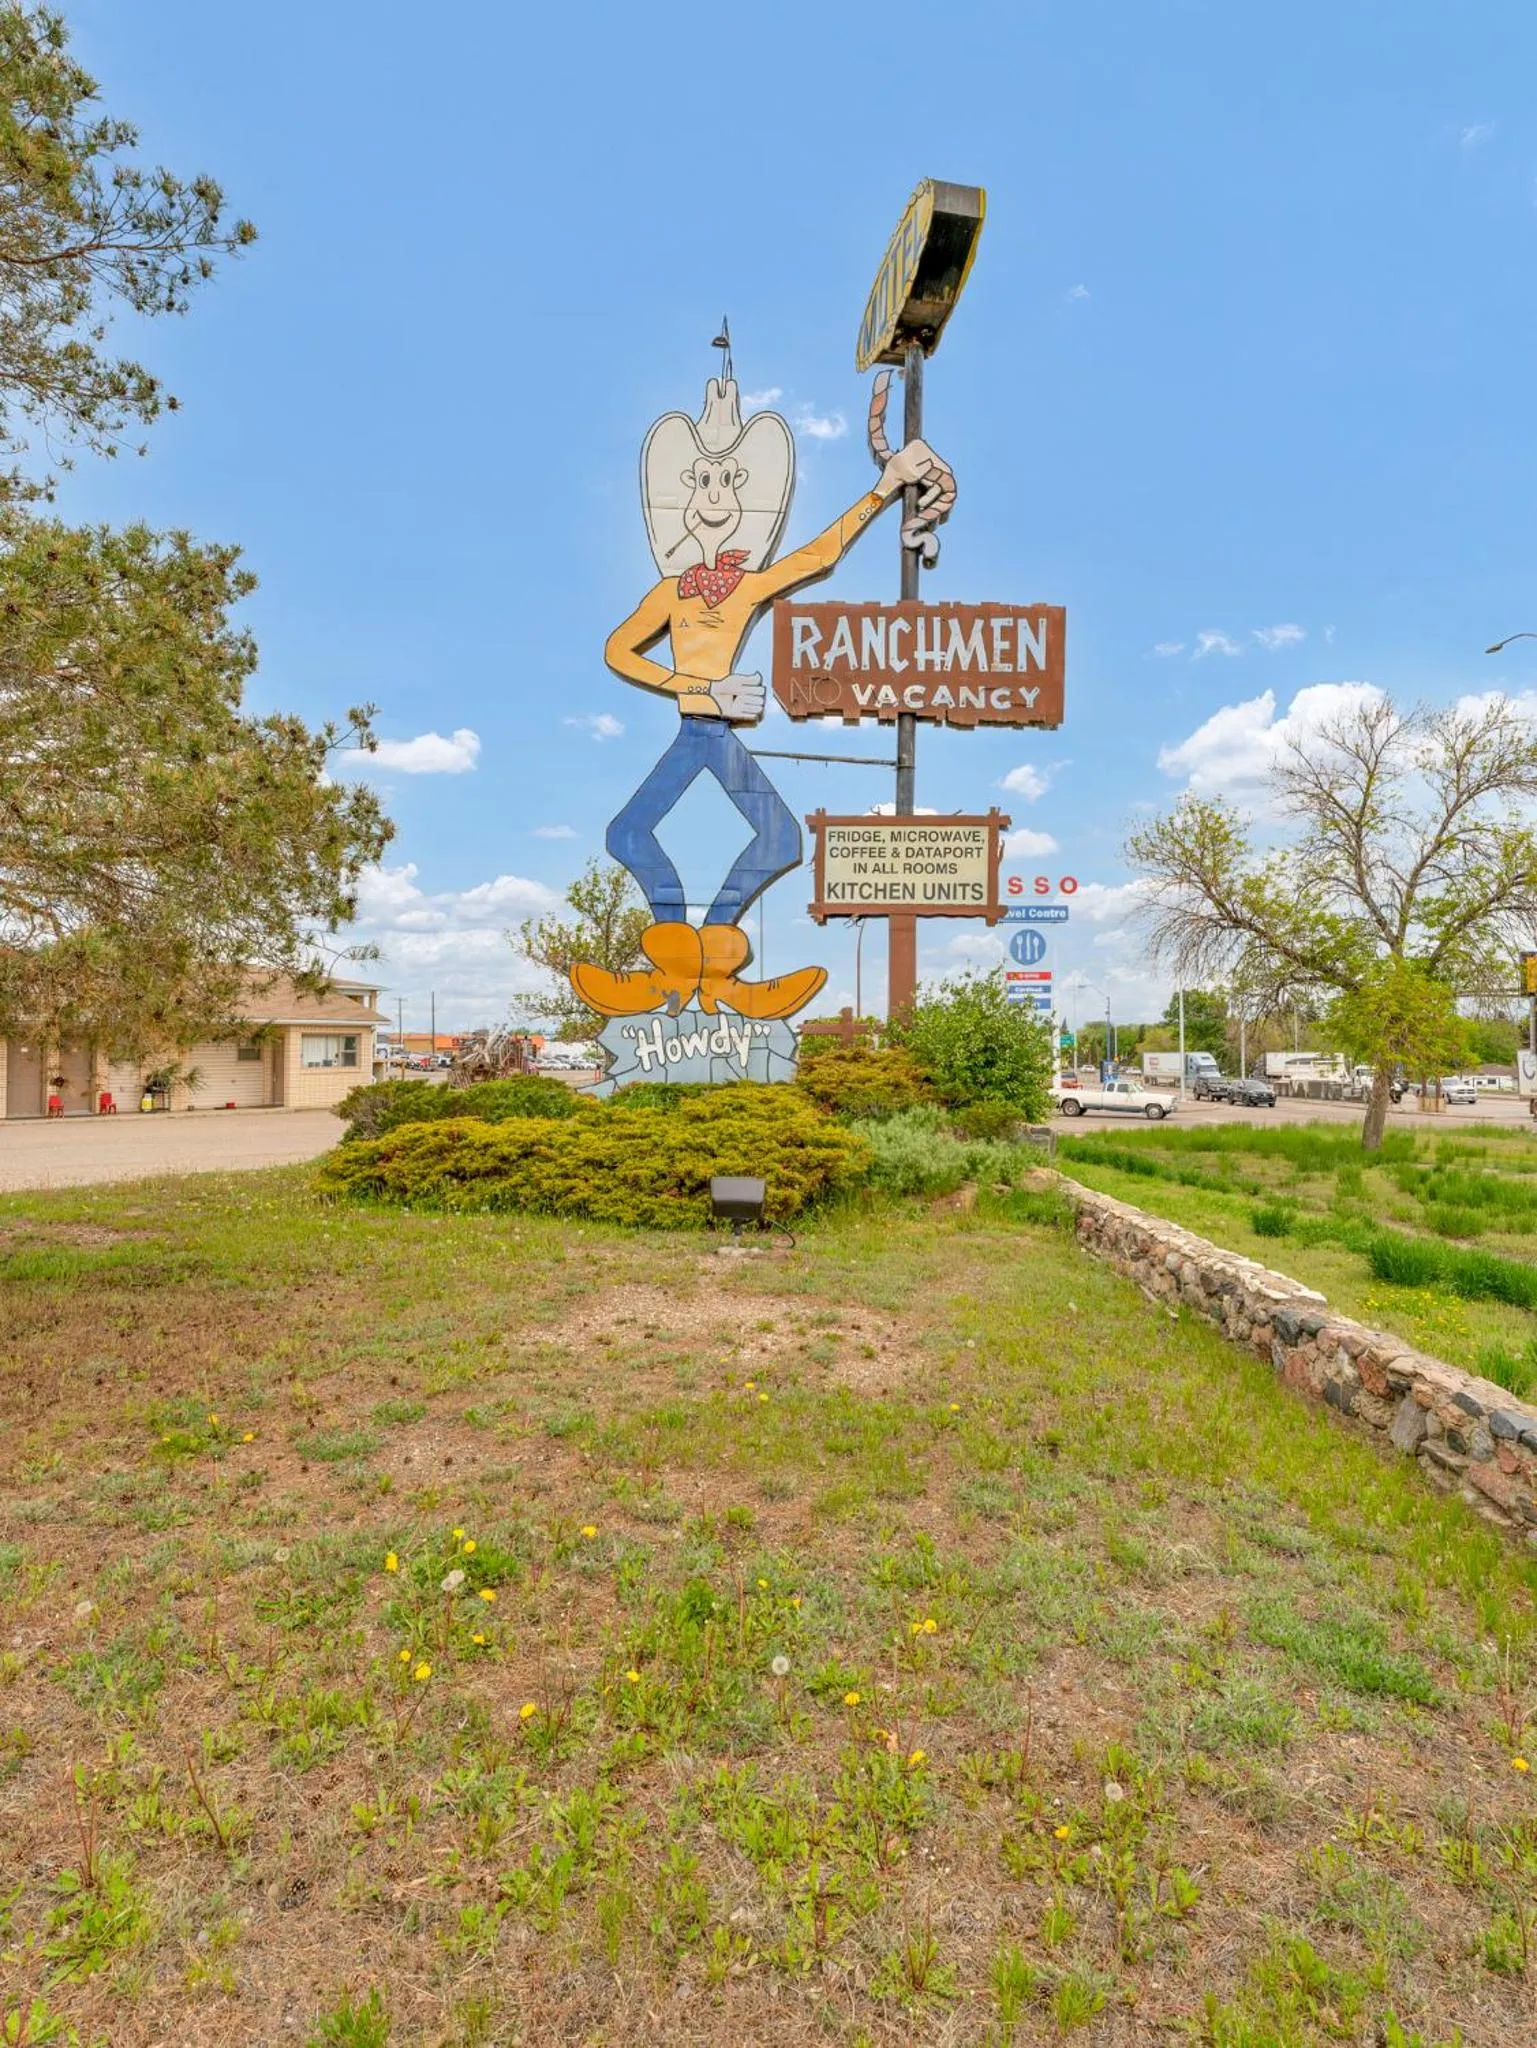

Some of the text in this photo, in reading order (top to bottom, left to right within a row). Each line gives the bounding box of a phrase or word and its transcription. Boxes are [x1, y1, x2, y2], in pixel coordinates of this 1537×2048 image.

[790, 615, 1047, 673] RANCHMEN
[790, 676, 1041, 709] NO VACANCY
[828, 830, 986, 844] FRIDGE, MICROWAVE,
[829, 846, 984, 858] COFFEE & DATAPORT
[853, 862, 958, 874] IN ALL ROOMS
[827, 882, 984, 901] KITCHEN UNITS
[1007, 875, 1078, 895] SSO
